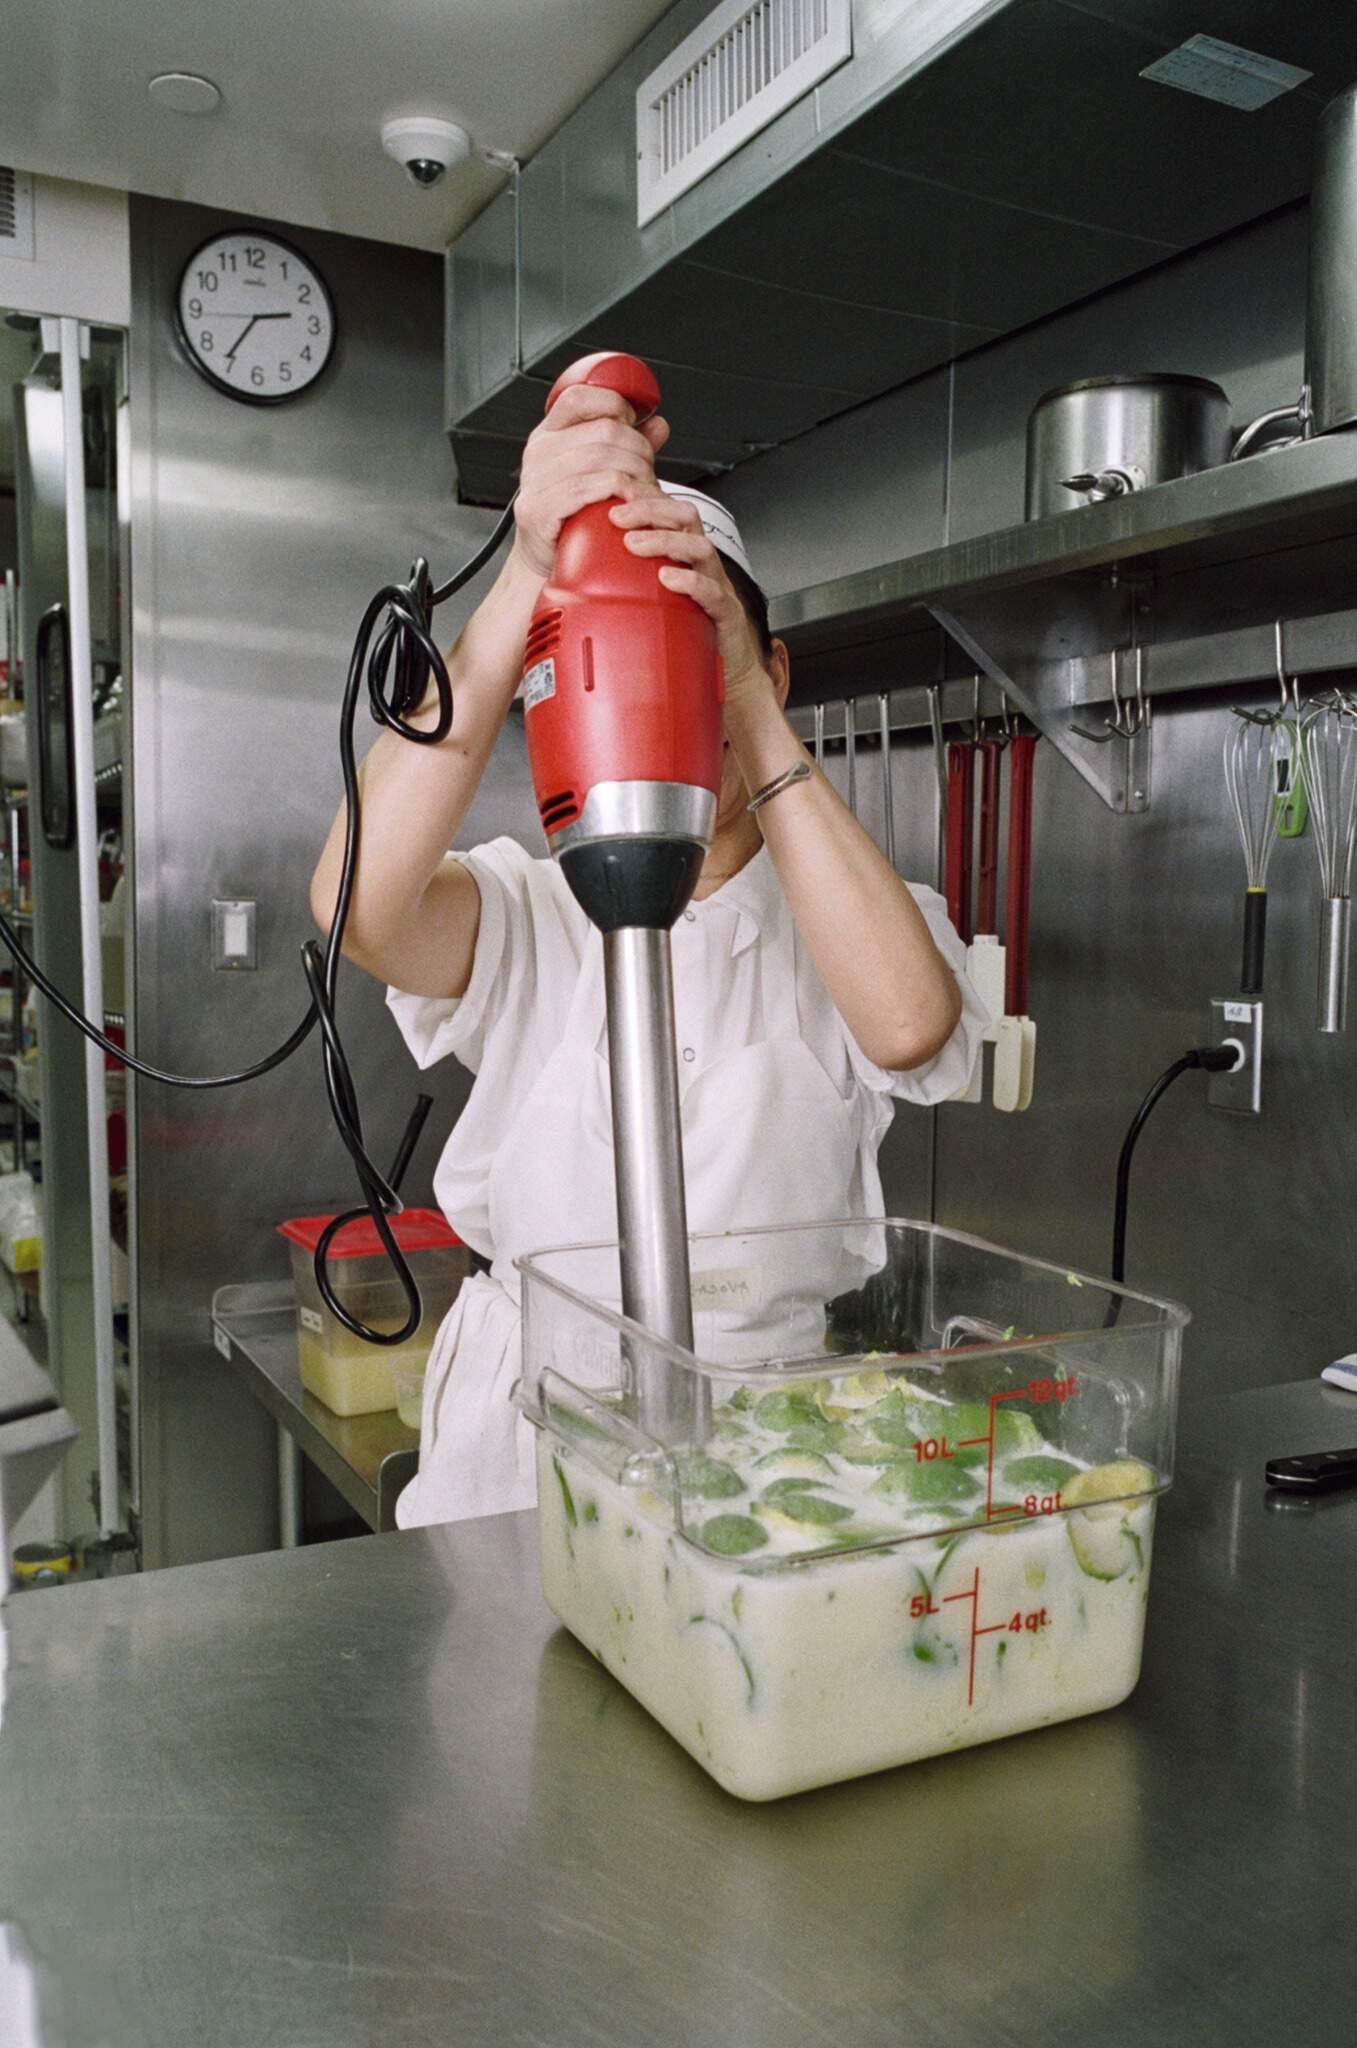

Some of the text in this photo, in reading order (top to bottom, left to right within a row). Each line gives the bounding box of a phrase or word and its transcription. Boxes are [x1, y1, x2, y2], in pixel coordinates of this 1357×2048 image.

[218, 252, 237, 272] 11
[245, 246, 266, 269] 12
[197, 271, 218, 292] 10
[280, 261, 288, 281] 1
[297, 284, 311, 305] 2
[188, 298, 202, 319] 9
[307, 315, 321, 336] 3
[200, 331, 213, 351] 8
[225, 354, 236, 373] 7
[300, 345, 312, 364] 4
[251, 366, 264, 386] 6
[279, 361, 292, 382] 5
[913, 1436, 956, 1463] 10L
[910, 1590, 940, 1620] 5L
